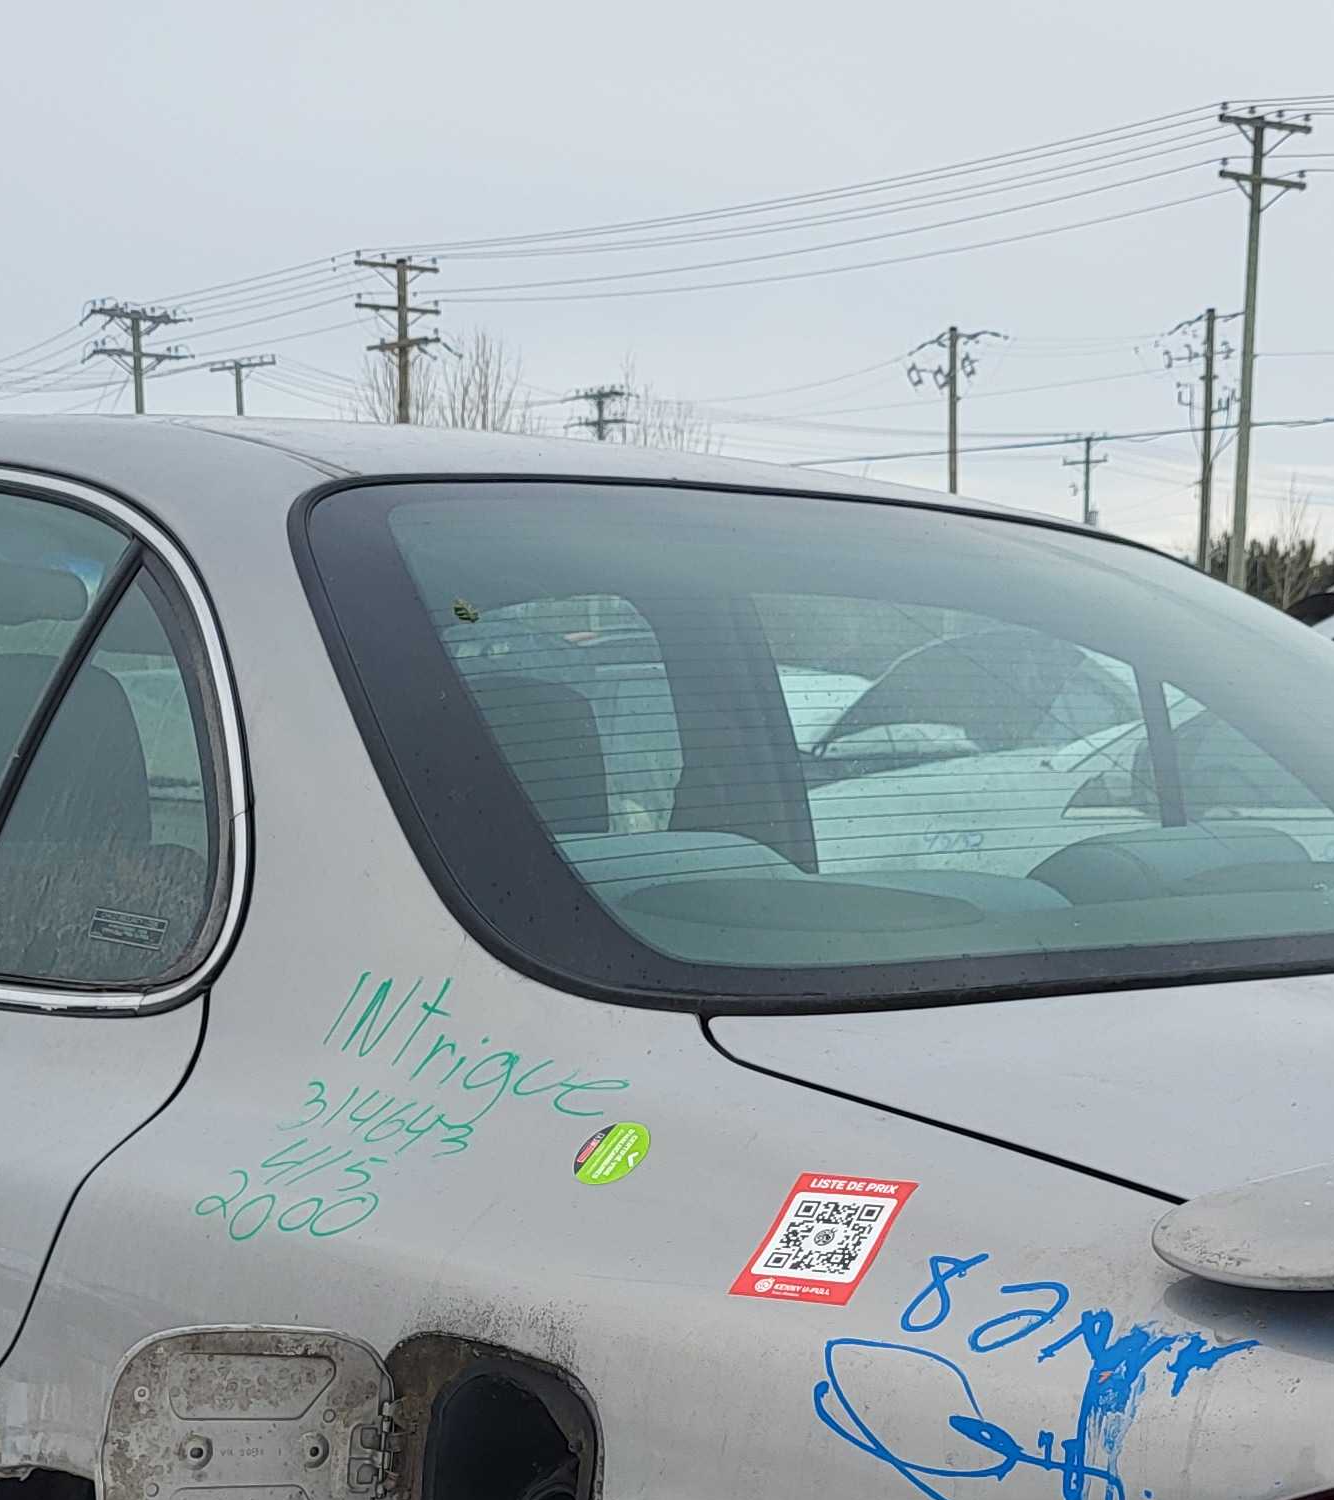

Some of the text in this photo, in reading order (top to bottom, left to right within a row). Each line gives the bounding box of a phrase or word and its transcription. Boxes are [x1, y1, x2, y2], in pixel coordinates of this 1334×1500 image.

[260, 1138, 389, 1192] 415
[809, 1177, 900, 1195] LISTE DE PRIX
